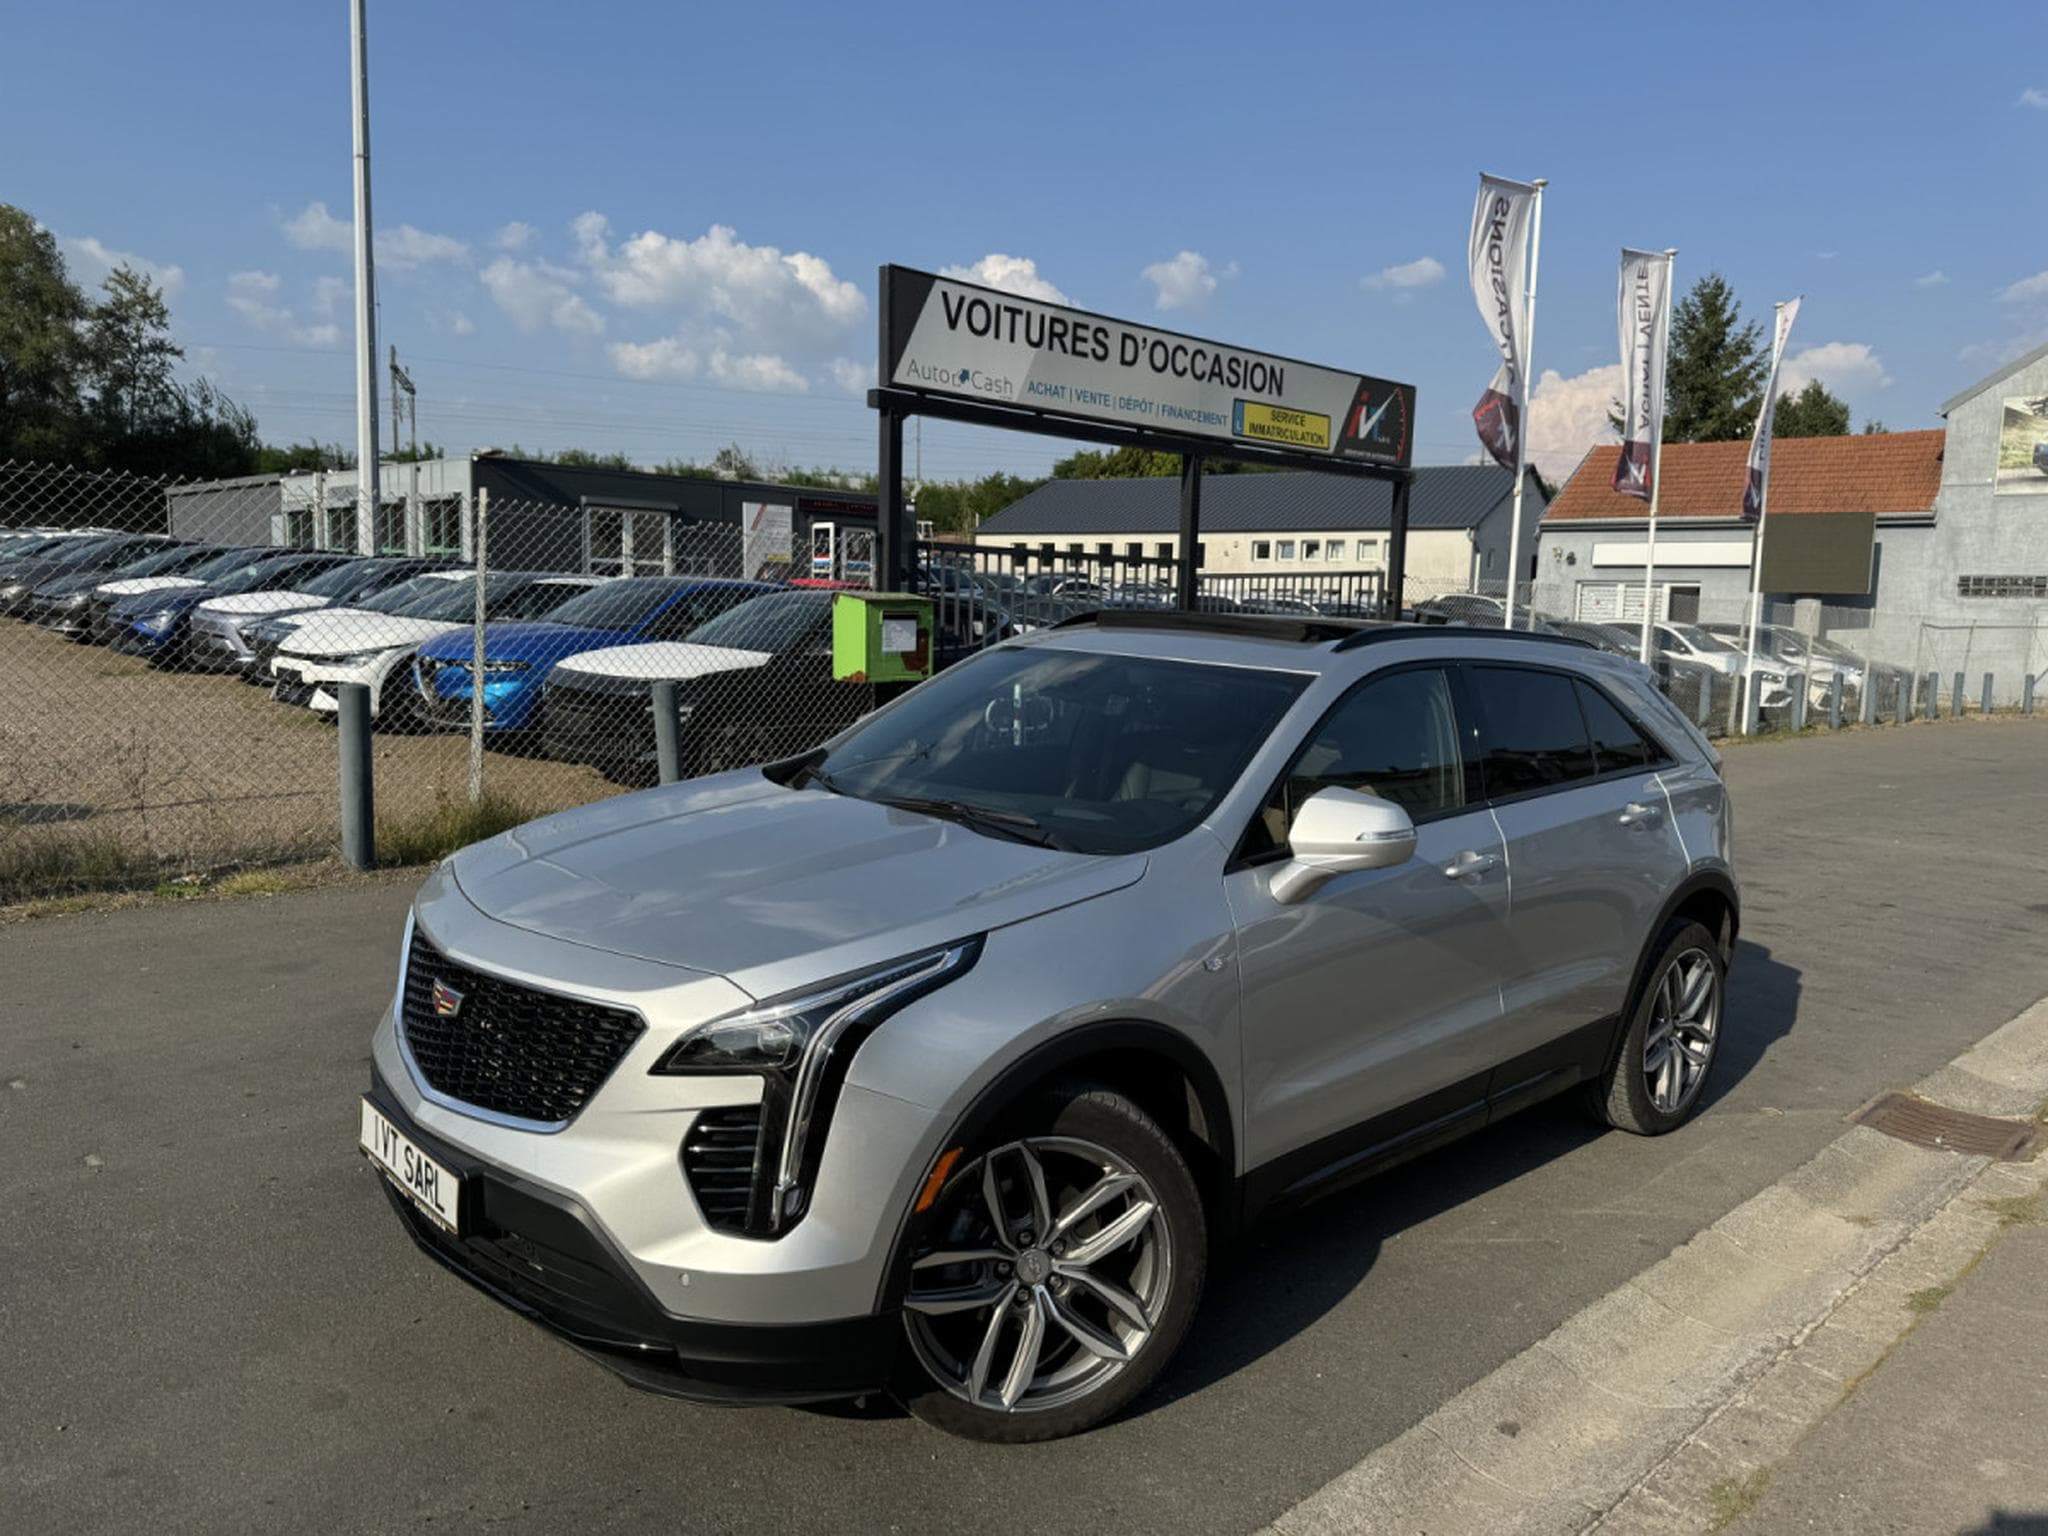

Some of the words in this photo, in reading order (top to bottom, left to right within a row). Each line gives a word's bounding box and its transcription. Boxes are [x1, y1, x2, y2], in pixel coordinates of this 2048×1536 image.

[942, 291, 1109, 362] VOITURES
[1120, 332, 1284, 397] D'OCCASION
[1028, 381, 1066, 400] ACHAT
[1075, 389, 1110, 408] VENTE
[1119, 396, 1154, 416] DÉPÔT
[1161, 404, 1229, 427] FINANCEMENT
[1271, 410, 1306, 427] SERVICE
[1248, 422, 1325, 445] IMMATRICULATION
[404, 1145, 445, 1214] SARL
